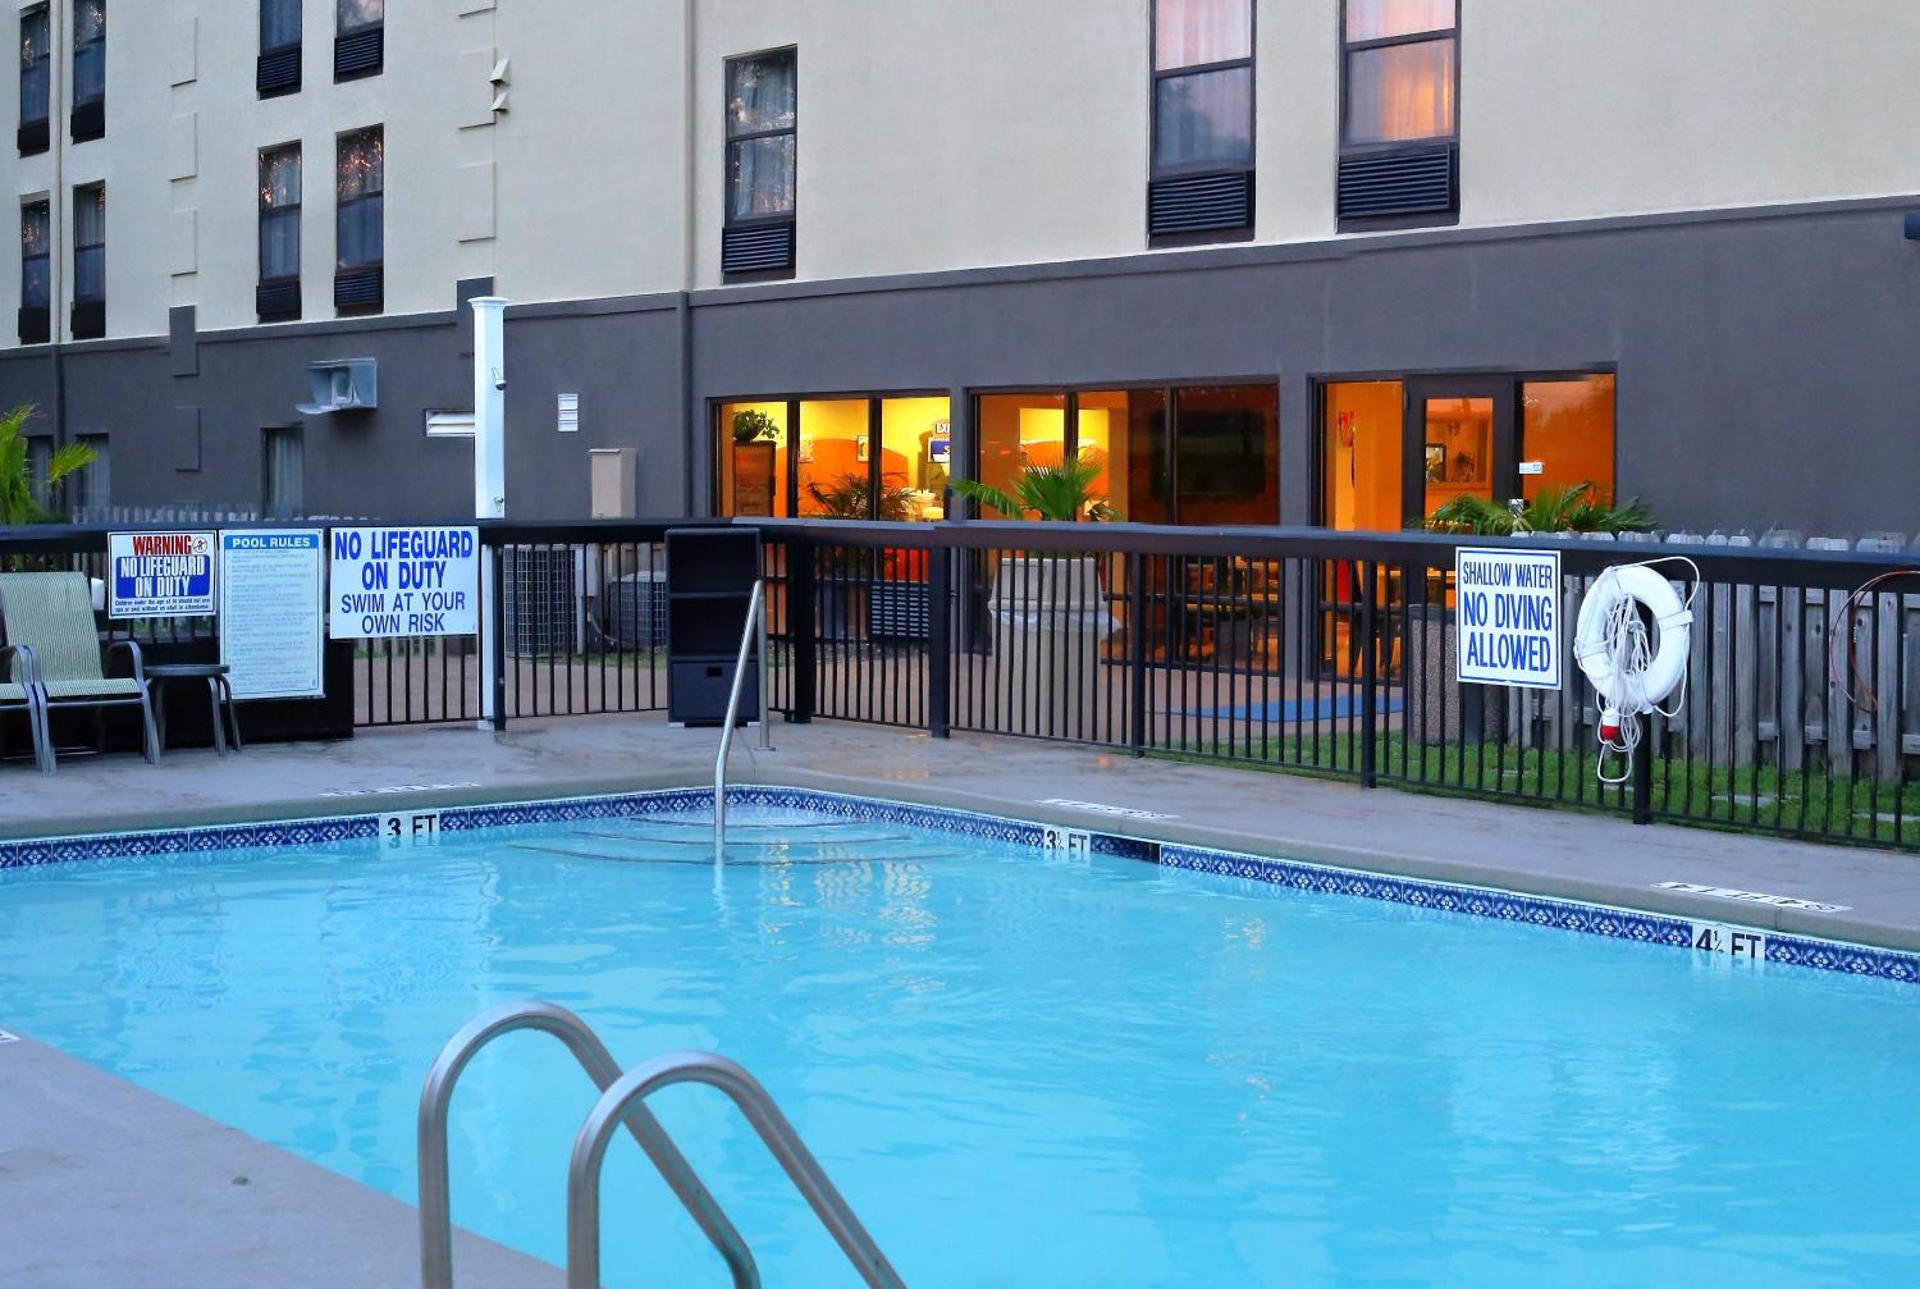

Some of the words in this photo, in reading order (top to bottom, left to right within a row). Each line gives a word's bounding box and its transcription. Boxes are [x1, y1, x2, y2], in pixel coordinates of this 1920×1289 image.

[133, 535, 192, 555] WARNING
[232, 538, 267, 548] POOL
[269, 537, 311, 548] RULES
[335, 532, 362, 560] NO
[371, 531, 473, 559] LIFEGUARD
[121, 557, 138, 577] NO
[140, 556, 205, 576] LIFEGUARD
[361, 561, 388, 590] ON
[398, 560, 447, 589] DUTY
[1463, 561, 1512, 587] SHALLOW
[1515, 563, 1553, 589] WATER
[135, 577, 152, 597] ON
[157, 576, 190, 596] DUTY
[341, 593, 385, 613] SWIM
[392, 592, 414, 612] AT
[422, 591, 466, 611] YOUR
[1464, 591, 1488, 627] NO
[1494, 593, 1552, 632] DIVING
[361, 614, 400, 634] OWN
[408, 613, 445, 632] RISK
[1466, 631, 1551, 672] ALLOWED
[387, 817, 402, 836] 3
[411, 814, 437, 834] FT
[1068, 833, 1088, 852] FT
[1731, 932, 1762, 958] FT
